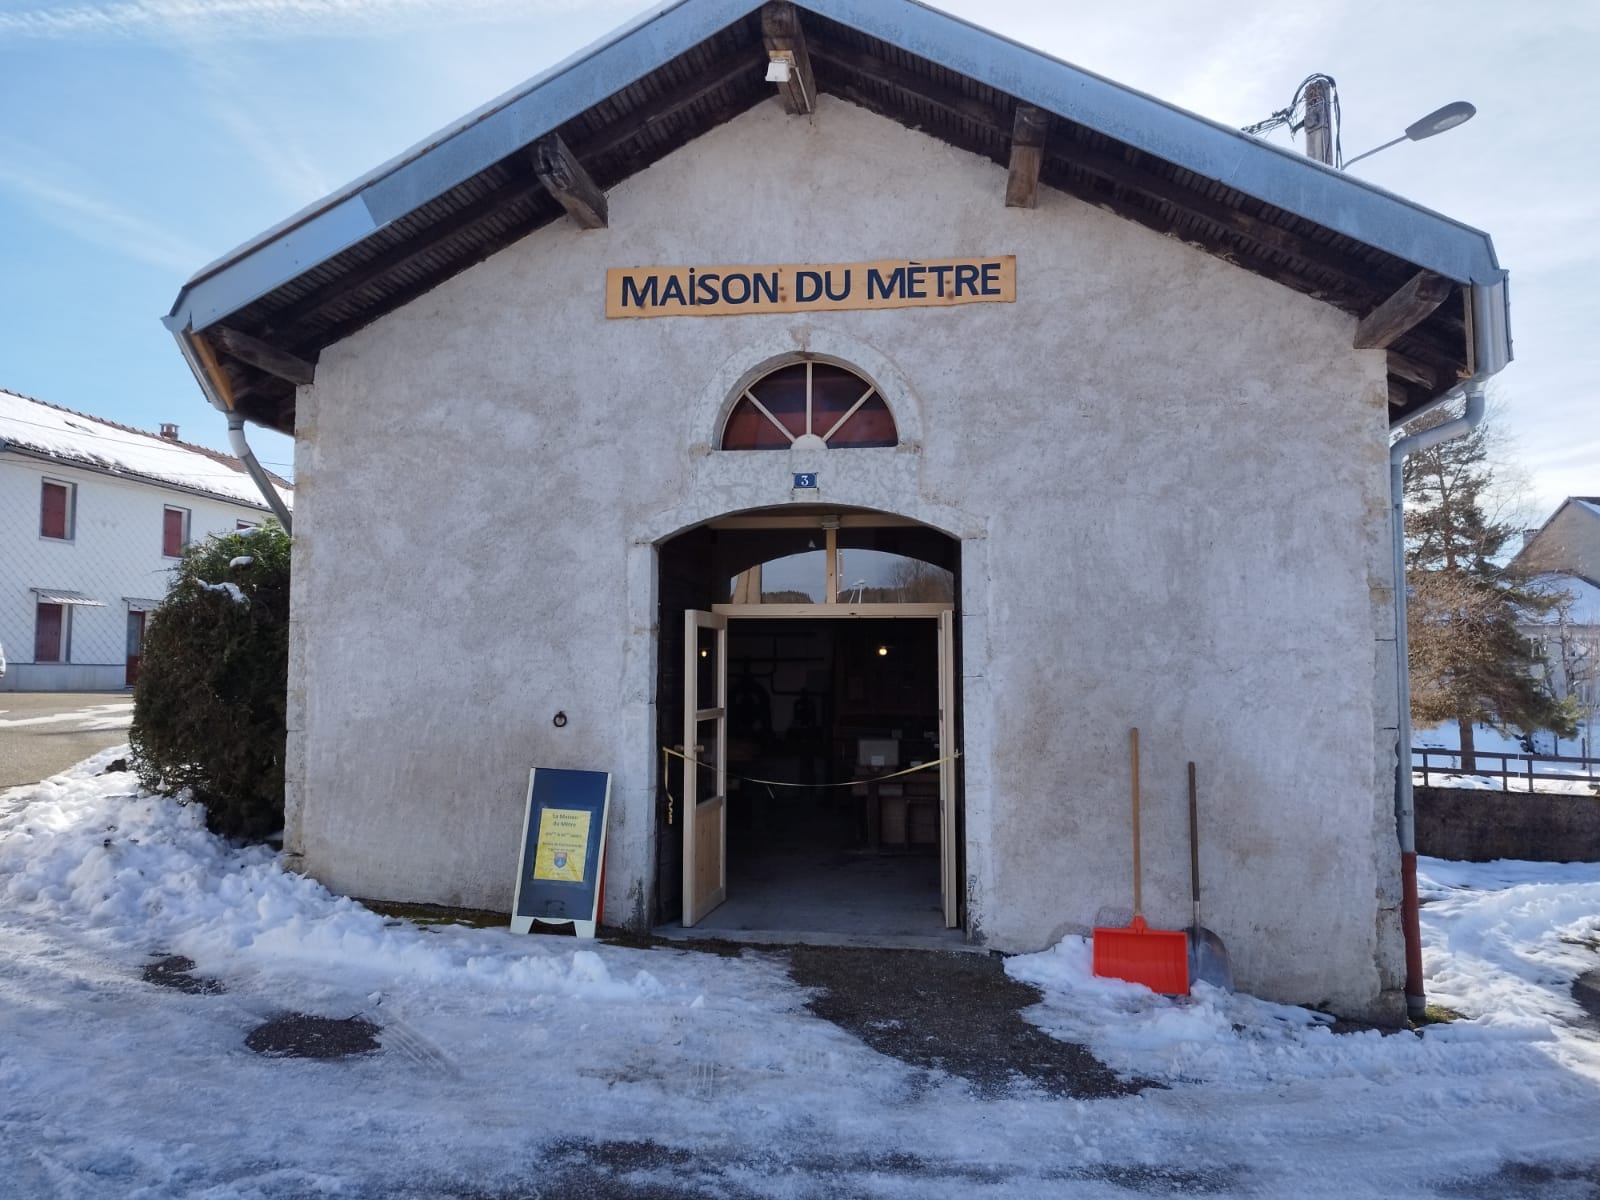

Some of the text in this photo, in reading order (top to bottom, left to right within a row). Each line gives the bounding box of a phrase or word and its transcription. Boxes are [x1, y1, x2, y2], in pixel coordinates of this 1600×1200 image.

[796, 269, 851, 303] DU
[867, 261, 1001, 300] MÈTRE
[801, 475, 809, 486] 3
